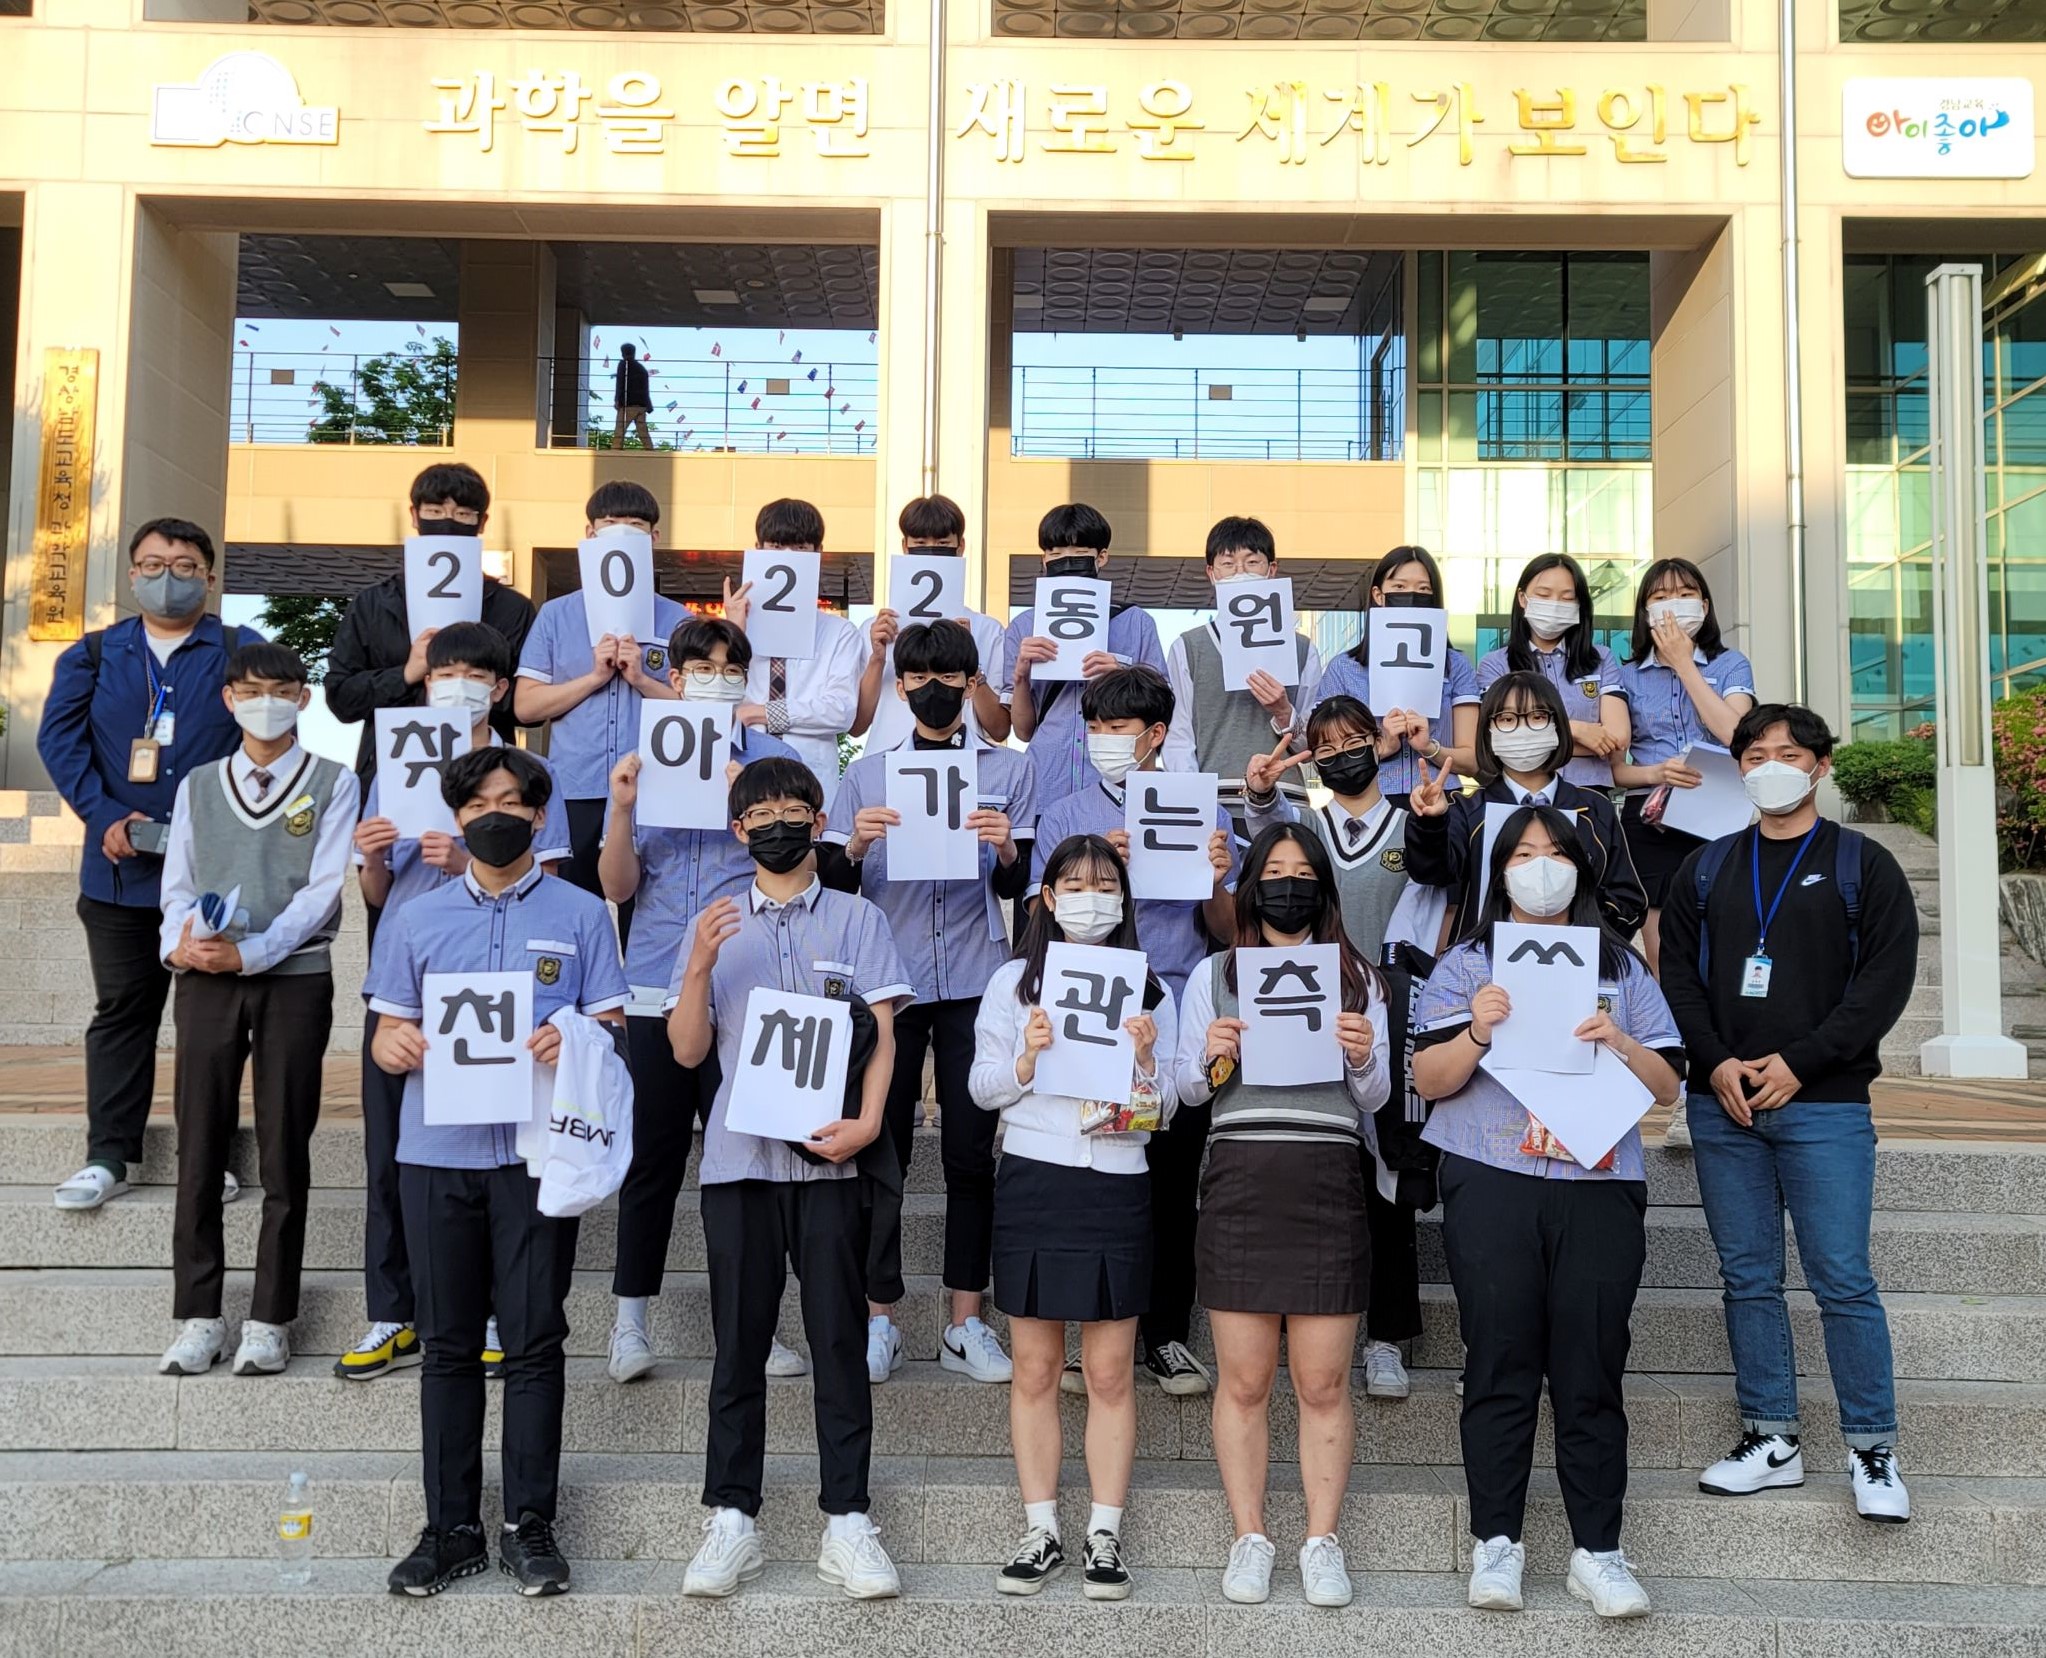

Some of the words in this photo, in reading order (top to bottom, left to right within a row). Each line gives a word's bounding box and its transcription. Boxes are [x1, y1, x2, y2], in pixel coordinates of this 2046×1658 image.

[423, 69, 675, 154] 과학을
[715, 75, 870, 158] 알면
[957, 78, 1206, 163] 새로운
[1236, 81, 1485, 166] 세계가
[1508, 83, 1760, 167] 보인다
[1866, 109, 2010, 156] 아이좋아
[428, 552, 461, 598] 2
[601, 551, 634, 597] 0
[762, 565, 796, 612] 2
[909, 570, 943, 618] 2
[1046, 589, 1099, 639] 동
[1229, 593, 1285, 648] 원
[1381, 623, 1434, 668] 고
[391, 721, 461, 788] 찾
[651, 716, 721, 780] 아
[899, 766, 968, 830] 가
[1139, 788, 1203, 851] 는
[439, 988, 516, 1065] 천
[1056, 970, 1134, 1046] 관
[1254, 960, 1326, 1031] 측
[751, 1009, 832, 1090] 체
